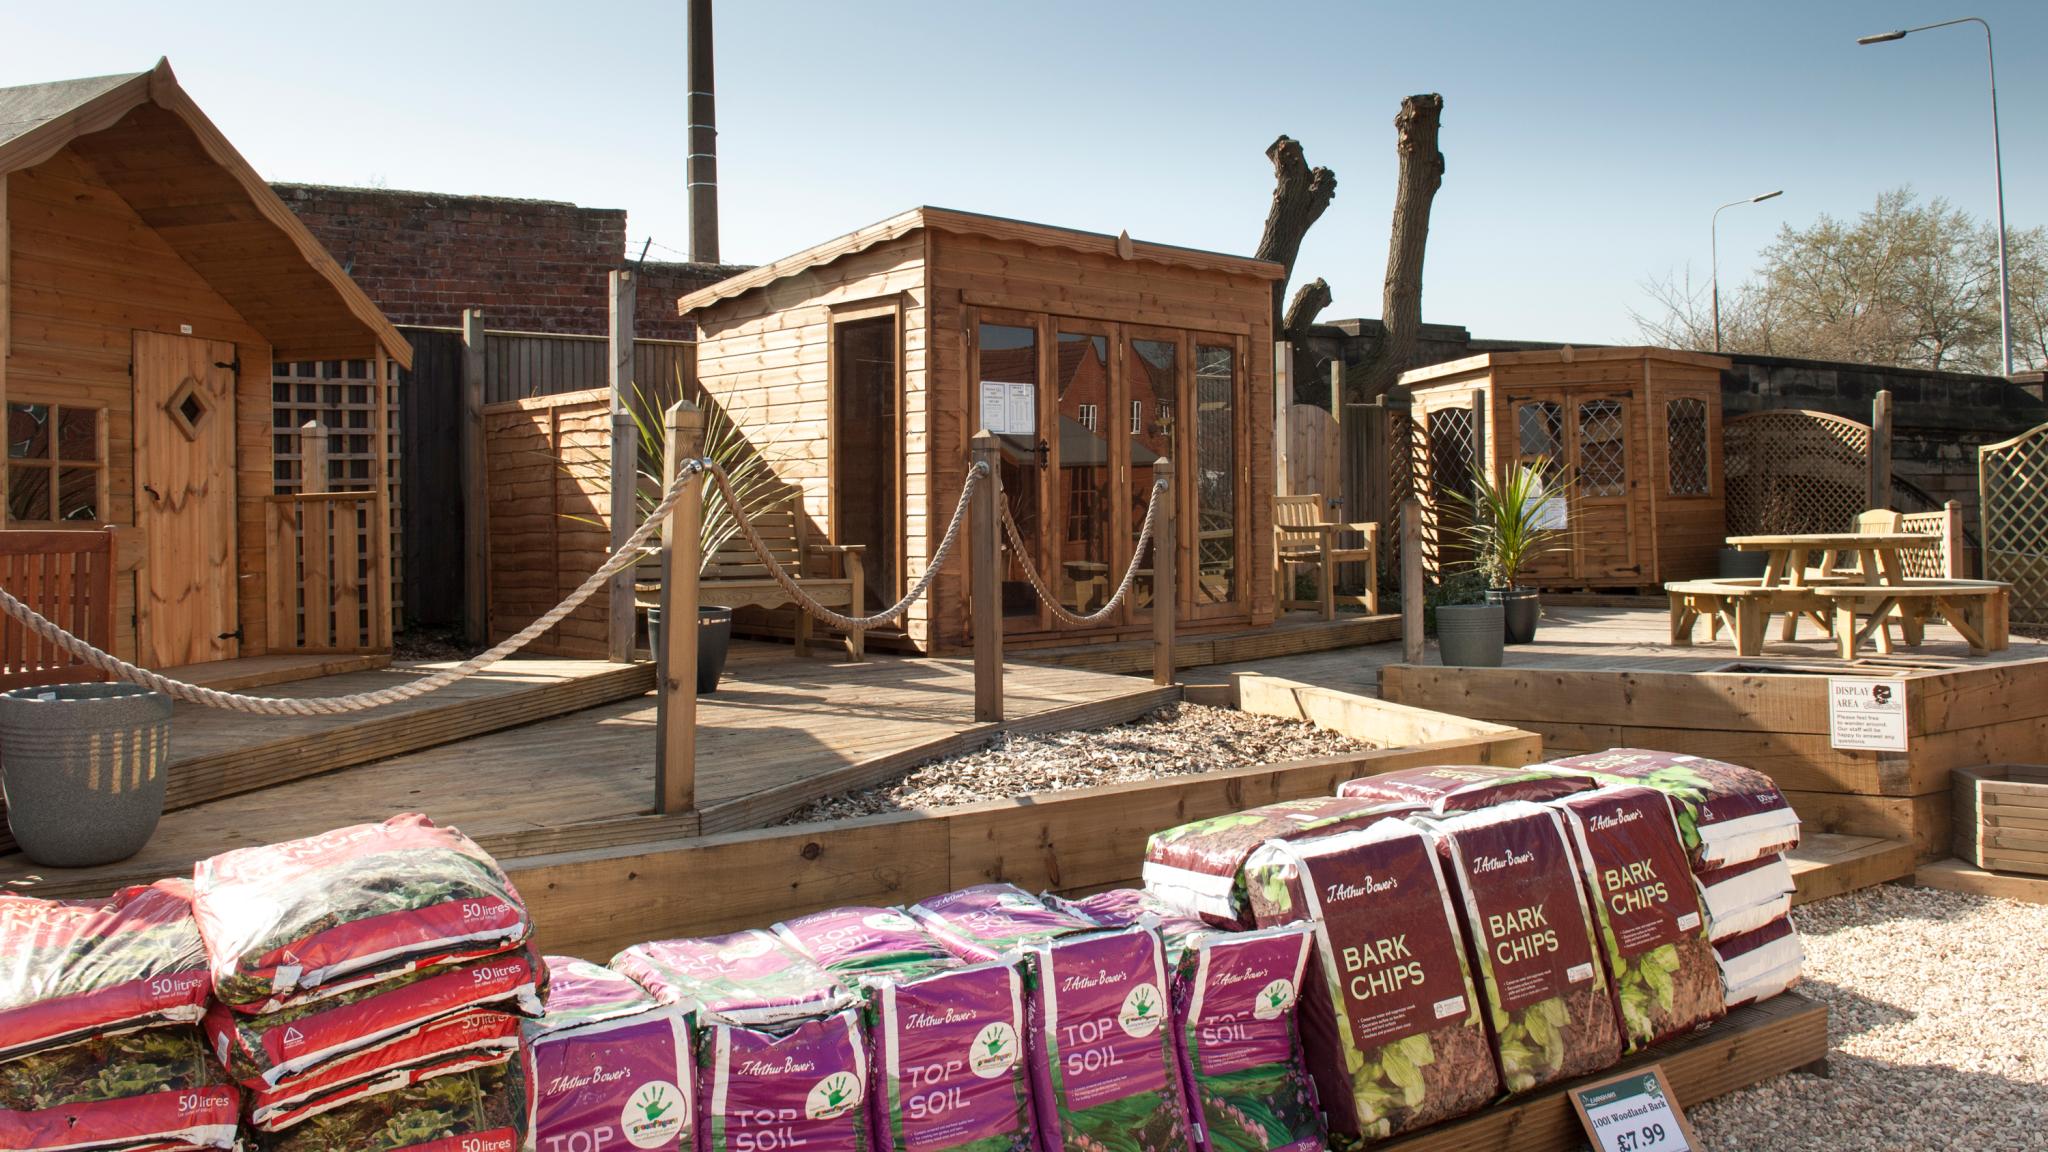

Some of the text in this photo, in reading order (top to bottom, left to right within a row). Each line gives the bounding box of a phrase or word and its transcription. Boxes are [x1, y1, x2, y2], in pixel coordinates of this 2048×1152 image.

[1836, 686, 1870, 696] DISPLAY
[1837, 699, 1859, 708] AREA
[1364, 875, 1398, 895] Bower's
[1605, 858, 1657, 892] BARK
[1611, 882, 1669, 916] CHIPS
[462, 903, 510, 918] 50 litres
[1488, 904, 1548, 939] BARK
[808, 925, 860, 944] TOP
[818, 934, 882, 954] SOIL
[1342, 934, 1412, 972] BARK
[1496, 929, 1559, 965] CHIPS
[472, 967, 492, 983] 50
[492, 964, 521, 978] litres
[1099, 970, 1127, 985] Bower's
[1351, 962, 1425, 1000] CHIPS
[152, 978, 172, 996] 50
[174, 977, 202, 992] litres
[462, 1016, 480, 1029] 50
[481, 1014, 509, 1025] litres
[945, 1008, 977, 1024] Bower's
[1063, 1018, 1112, 1046] TOP
[1202, 1024, 1254, 1046] SOIL
[784, 1056, 816, 1074] Bower's
[1068, 1045, 1124, 1076] SOIL
[592, 1065, 631, 1084] Bower's
[906, 1060, 962, 1088] TOP
[178, 1094, 197, 1112] 50
[199, 1096, 229, 1108] litres
[910, 1086, 970, 1119] SOIL
[1612, 1107, 1648, 1122] Woodland
[1649, 1100, 1667, 1114] Bark
[734, 1108, 797, 1128] TOP
[462, 1138, 511, 1152] 50 litres
[546, 1126, 614, 1152] TOP
[736, 1127, 807, 1152] SOIL
[1616, 1123, 1666, 1152] £7.99
